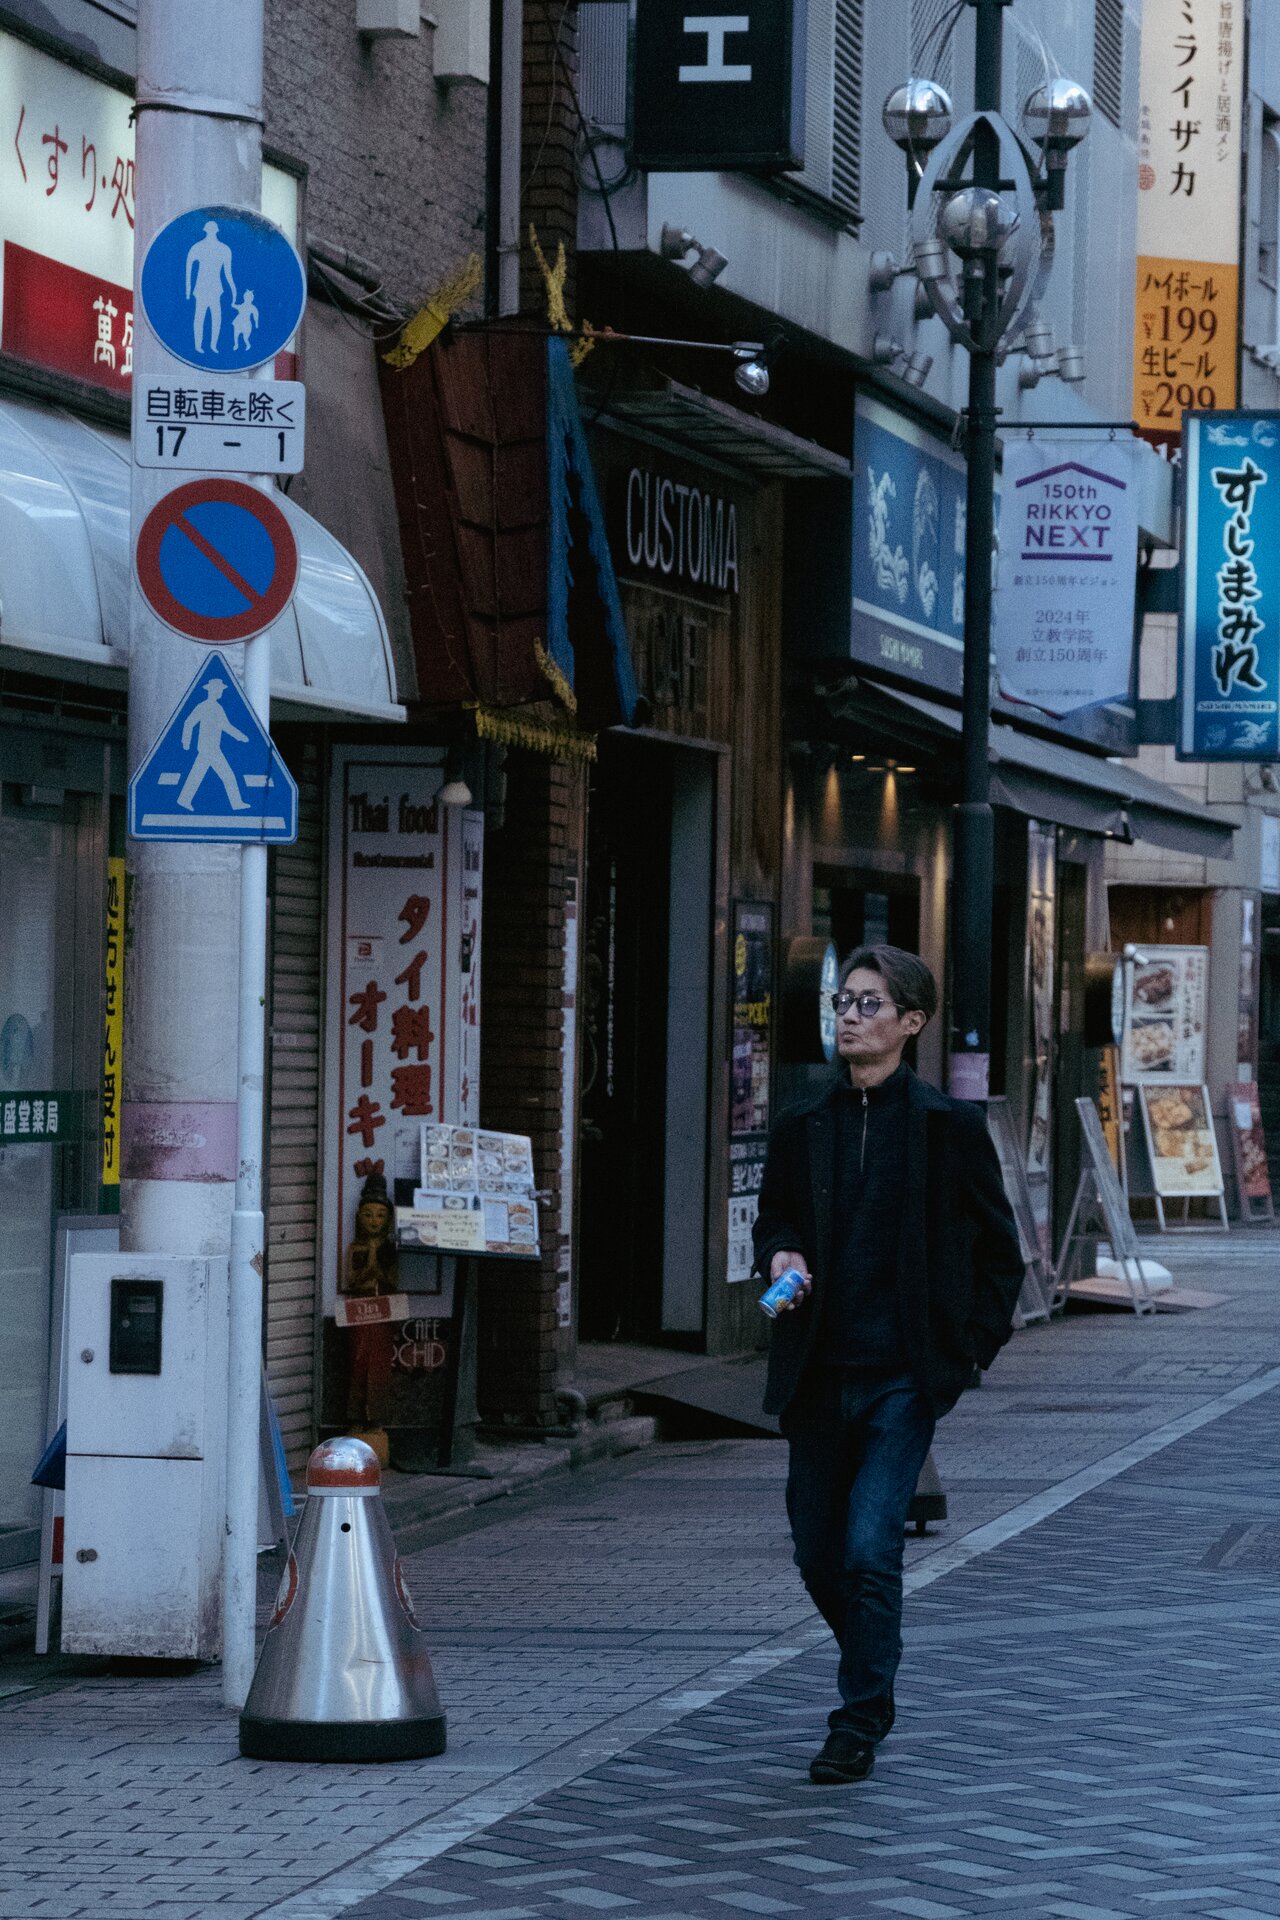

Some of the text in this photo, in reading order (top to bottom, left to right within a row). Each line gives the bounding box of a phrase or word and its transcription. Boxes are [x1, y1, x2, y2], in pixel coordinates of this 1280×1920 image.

[1169, 0, 1201, 197] ミライザカ
[1143, 271, 1218, 302] ハイボール
[1141, 346, 1217, 379] 生ビール
[147, 387, 295, 422] 自転車を除く
[156, 425, 187, 457] 17
[277, 431, 285, 462] 1
[1043, 484, 1097, 500] 150th
[1027, 503, 1112, 520] RIKKYO
[627, 467, 739, 593] CUSTOMA
[1025, 525, 1110, 548] NEXT
[1212, 457, 1268, 697] すしまみれ
[1035, 610, 1091, 625] 2024年
[1031, 628, 1094, 645] 立教学院
[1015, 646, 1108, 663] 創立150周年
[350, 791, 439, 833] Thai food
[389, 894, 435, 1116] タイ料理
[0, 1098, 58, 1134] 盛堂薬局
